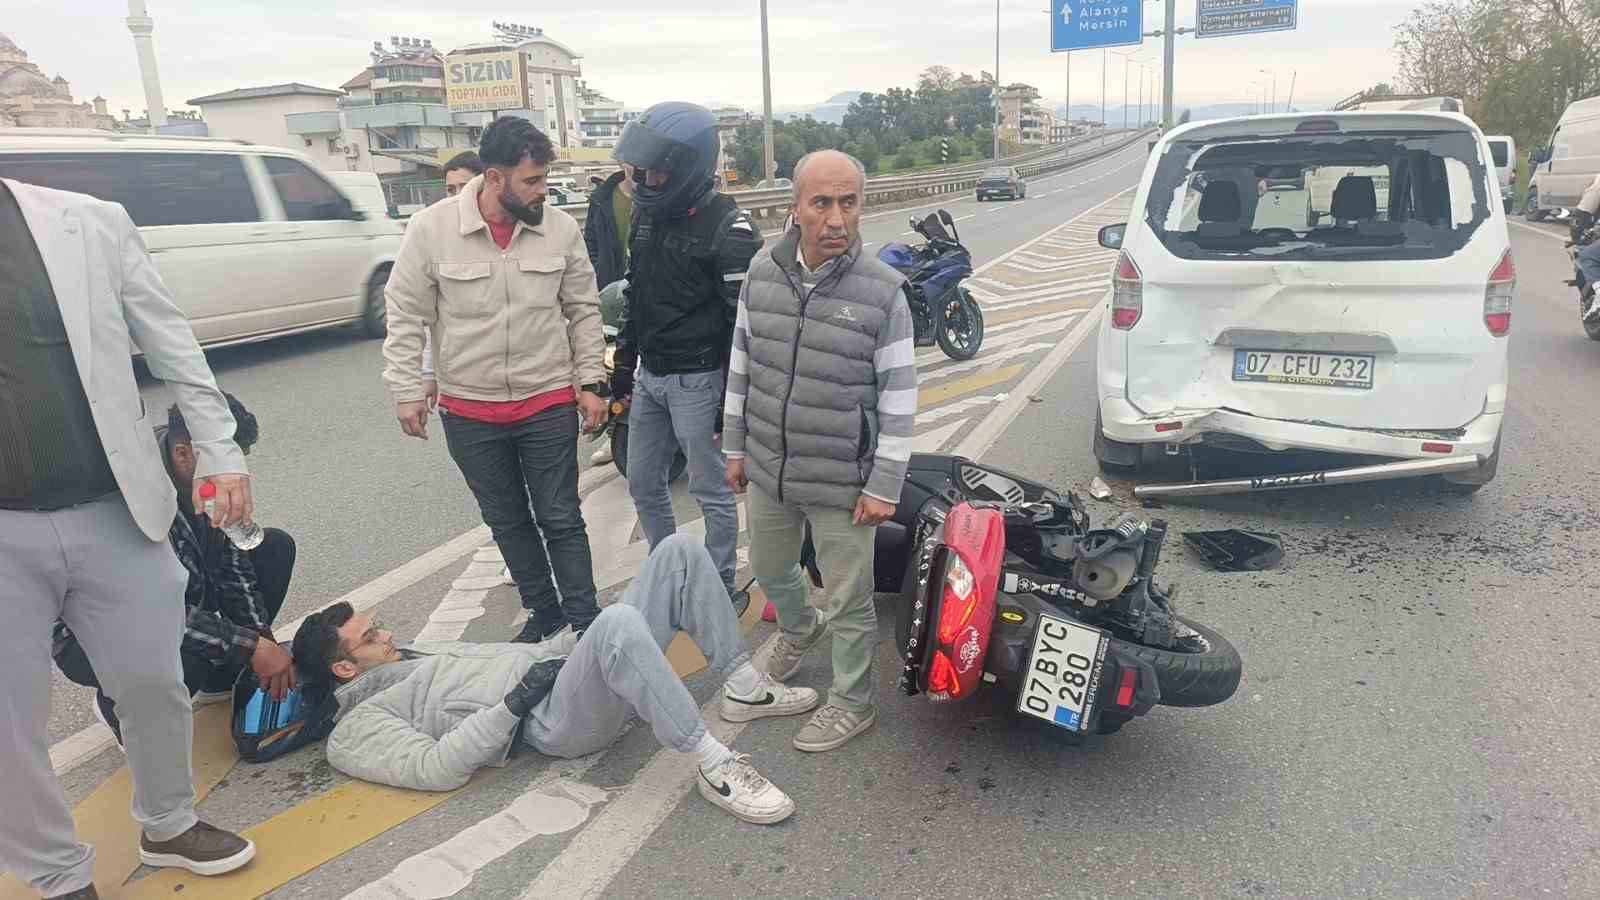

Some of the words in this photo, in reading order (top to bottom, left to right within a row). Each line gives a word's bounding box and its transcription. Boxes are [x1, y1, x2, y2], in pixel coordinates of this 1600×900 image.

[1080, 6, 1128, 18] Alanya
[1080, 19, 1127, 31] Mersin
[449, 87, 489, 100] TOPTAN
[492, 85, 517, 97] GIDA
[1247, 353, 1272, 373] 07
[1282, 355, 1321, 376] CFU
[1329, 357, 1369, 379] 232
[1031, 581, 1086, 602] YAMAHA
[1035, 623, 1068, 676] BYC
[1058, 653, 1091, 706] 280
[1026, 678, 1052, 713] 07
[1070, 712, 1080, 724] TR
